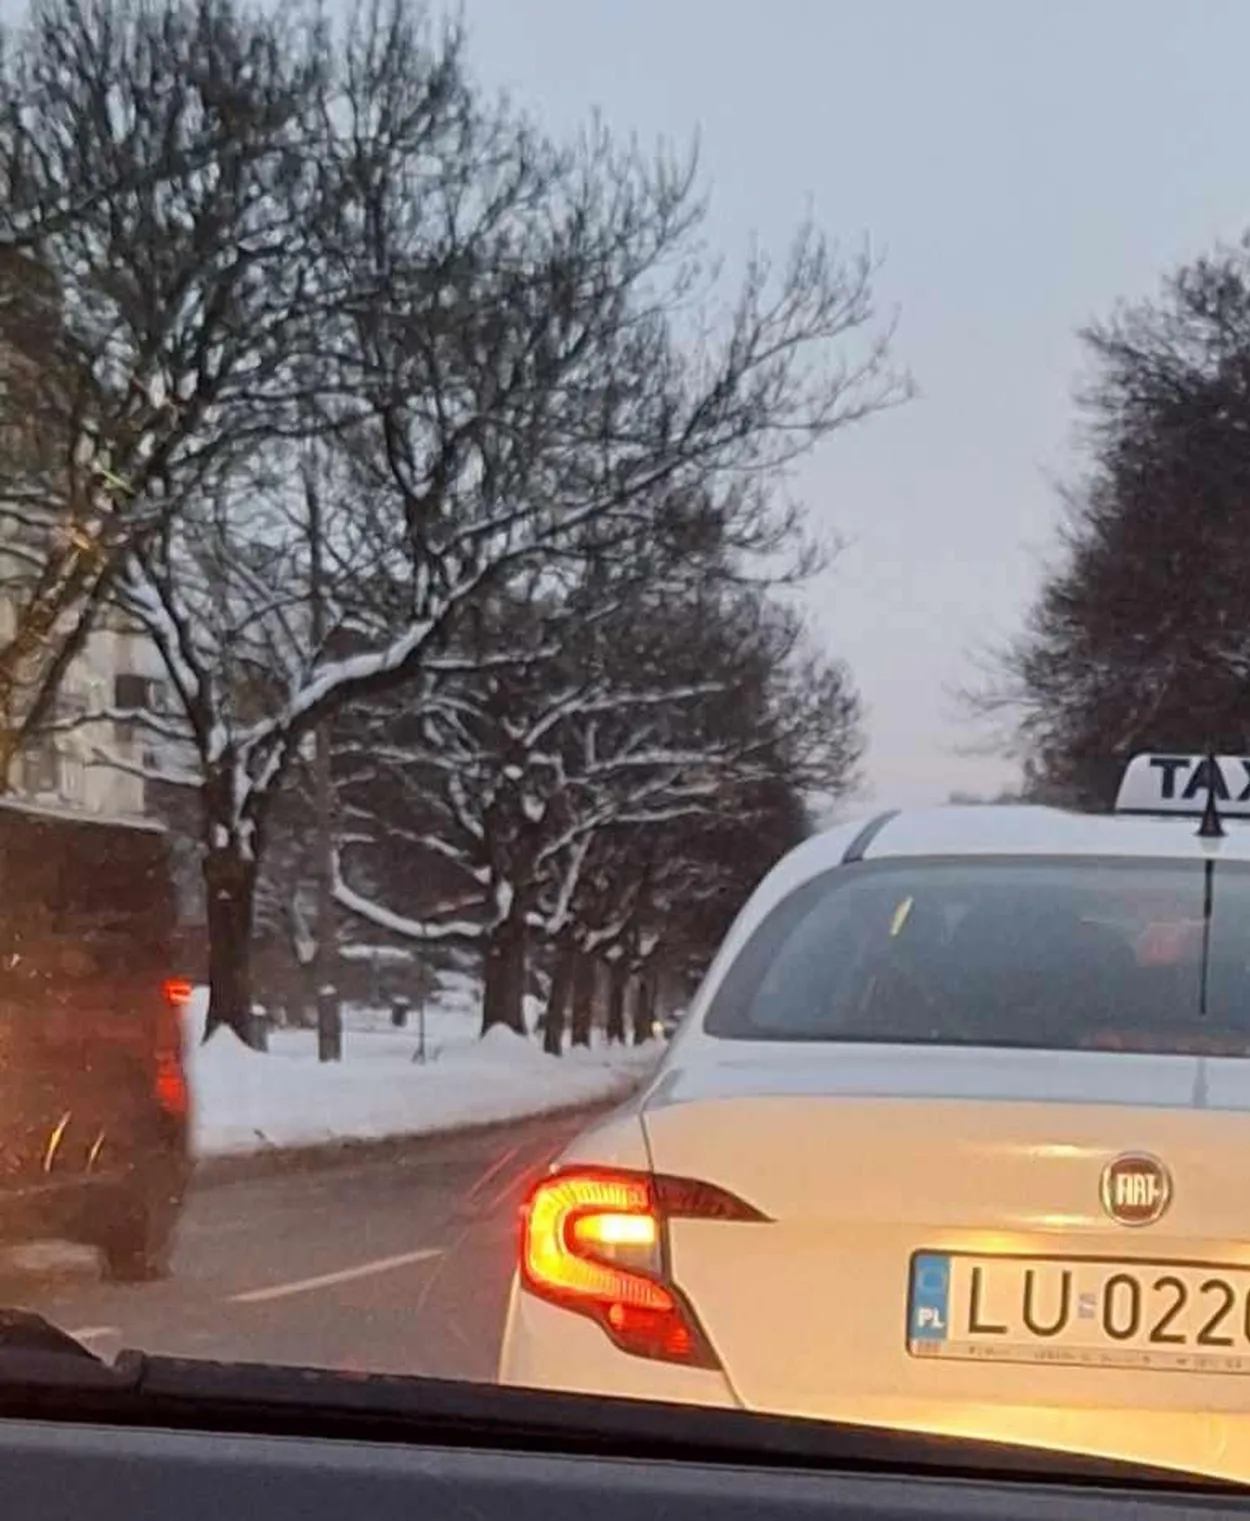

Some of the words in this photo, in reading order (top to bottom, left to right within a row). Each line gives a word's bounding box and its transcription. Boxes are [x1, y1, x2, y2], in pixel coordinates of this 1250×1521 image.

[1116, 1172, 1155, 1206] FIAT
[917, 1305, 945, 1329] PL
[968, 1266, 1073, 1338] LU
